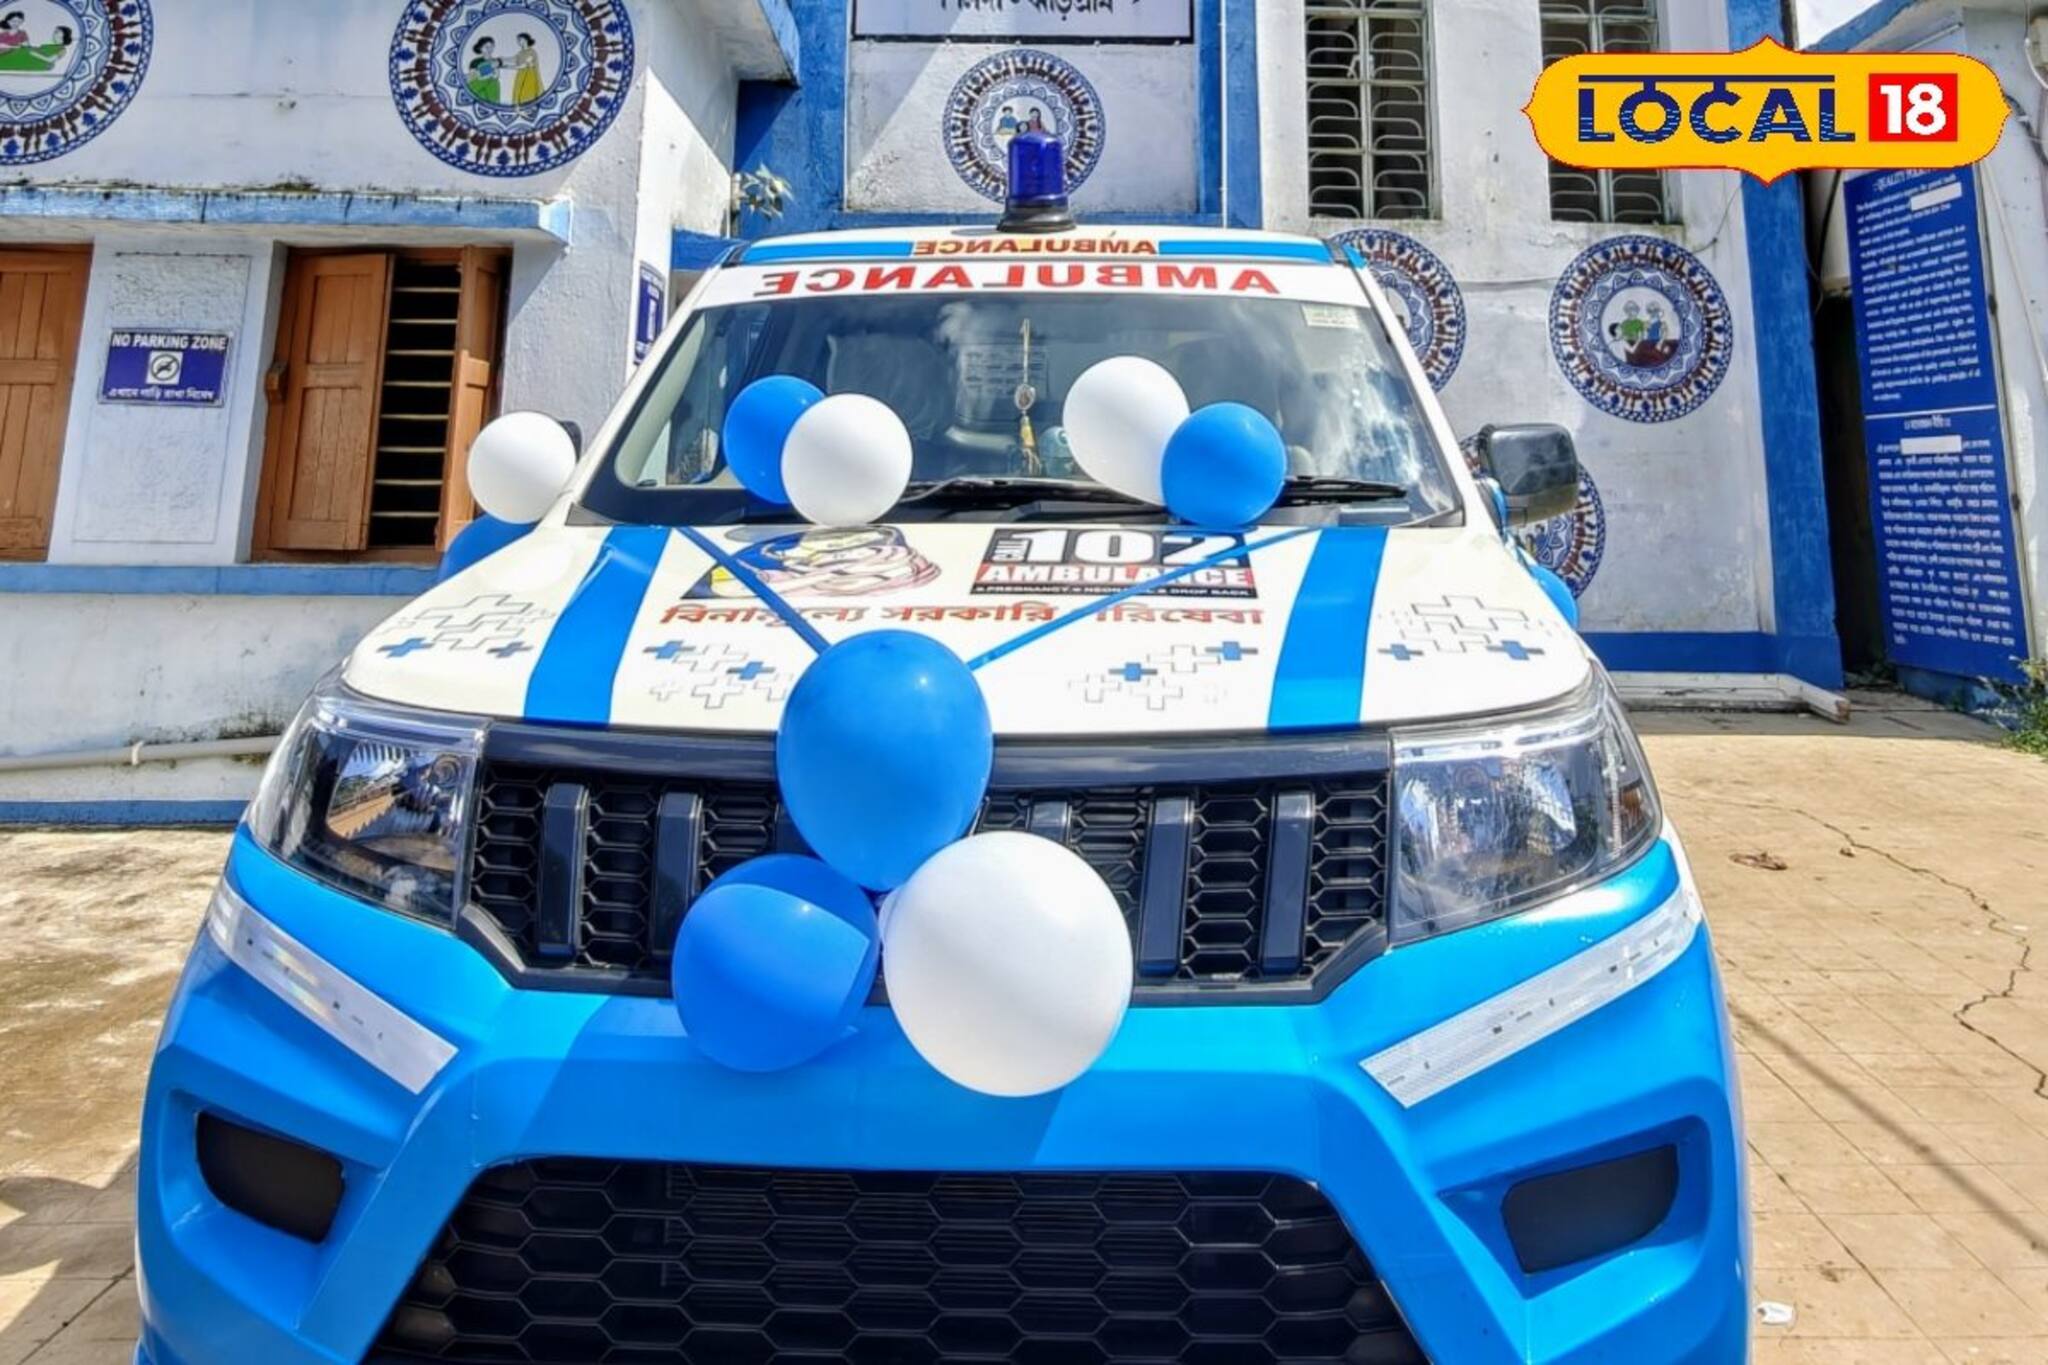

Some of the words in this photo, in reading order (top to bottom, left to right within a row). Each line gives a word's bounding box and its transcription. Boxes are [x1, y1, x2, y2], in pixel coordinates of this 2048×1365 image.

[112, 334, 131, 347] NO
[132, 334, 189, 350] PARKING
[191, 336, 227, 351] ZONE
[1011, 529, 1240, 566] 102
[880, 600, 1059, 622] সরকারি
